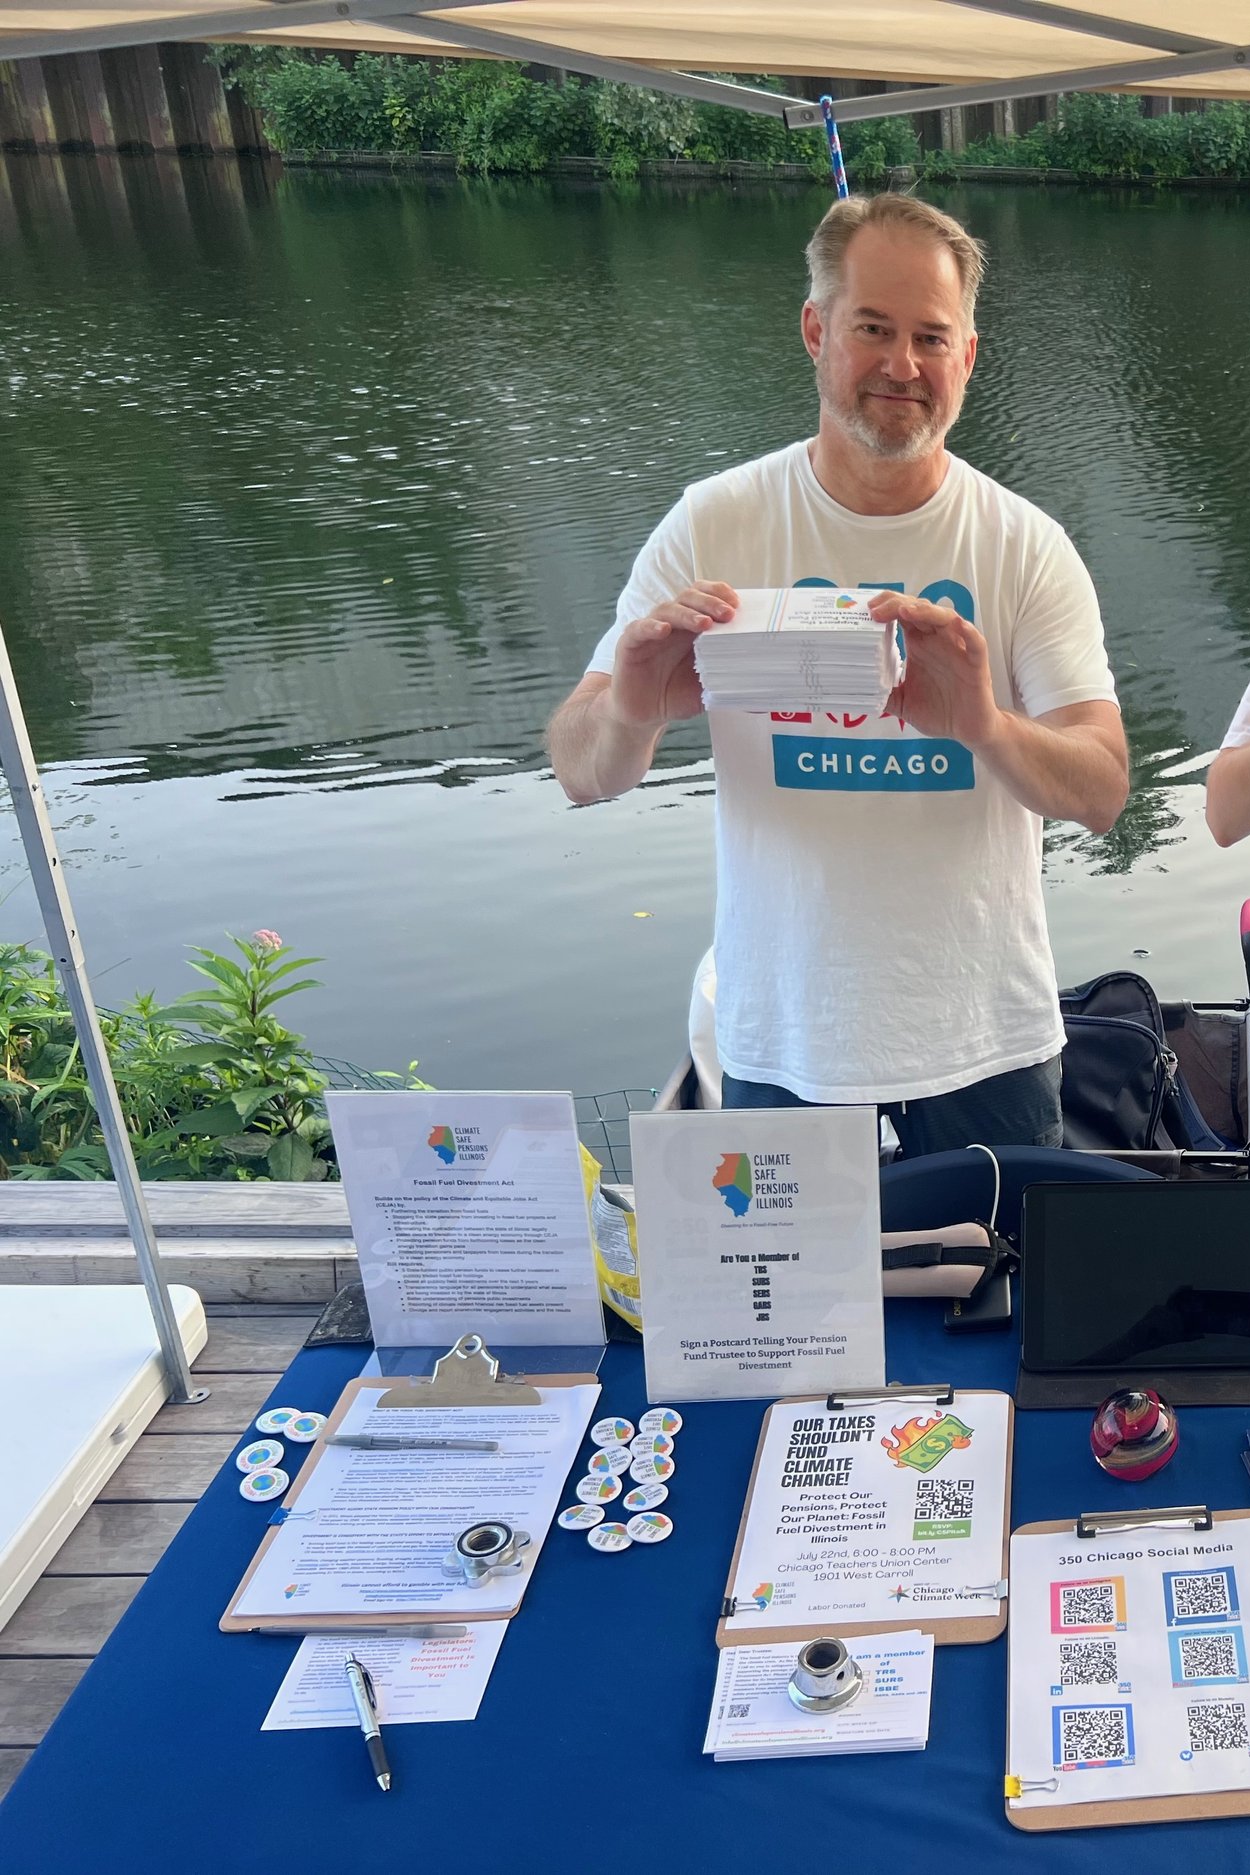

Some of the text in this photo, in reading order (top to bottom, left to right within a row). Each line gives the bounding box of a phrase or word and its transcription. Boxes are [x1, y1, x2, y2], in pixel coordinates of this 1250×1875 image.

[797, 752, 949, 775] CHICAGO
[455, 1127, 480, 1135] CLIMATE
[459, 1153, 485, 1161] ILLINOIS
[754, 1154, 791, 1166] CLIMATE
[754, 1169, 776, 1180] SAFE
[755, 1183, 799, 1195] PENSIONS
[756, 1198, 793, 1209] ILLINOIS
[721, 1254, 734, 1264] Are
[735, 1254, 749, 1263] You
[758, 1253, 790, 1262] Member
[792, 1252, 800, 1261] of
[680, 1339, 701, 1349] Sign
[710, 1337, 750, 1347] Postcard
[752, 1336, 785, 1346] Telling
[786, 1336, 808, 1345] Your
[810, 1334, 847, 1343] Pension
[684, 1346, 845, 1361] Fund Trustee to Support Fossil Fuel
[738, 1361, 792, 1370] Divestment
[793, 1415, 876, 1432] OUR TAXES
[790, 1429, 875, 1446] SHOULDN'T
[787, 1446, 828, 1459] FUND
[784, 1457, 854, 1474] CLIMATE
[781, 1472, 850, 1488] CHANGE!
[800, 1492, 873, 1502] Protect Our
[781, 1501, 888, 1514] Pensions, Protect
[781, 1511, 885, 1523] Our Planet: Fossil
[776, 1522, 886, 1535] Fuel Divestment in
[811, 1534, 849, 1544] Illinois
[797, 1552, 818, 1561] July
[821, 1550, 850, 1560] 22nd,
[853, 1549, 879, 1557] 6:00
[889, 1547, 915, 1556] 8:00
[918, 1547, 936, 1555] PM
[1059, 1543, 1233, 1566] 350 Chicago Social Media
[777, 1556, 952, 1573] Chicago Teachers Union Center
[814, 1569, 914, 1581] 1901 West Carroll
[913, 1586, 955, 1594] Chicago
[912, 1593, 953, 1602] Climate
[832, 1602, 866, 1610] Donated
